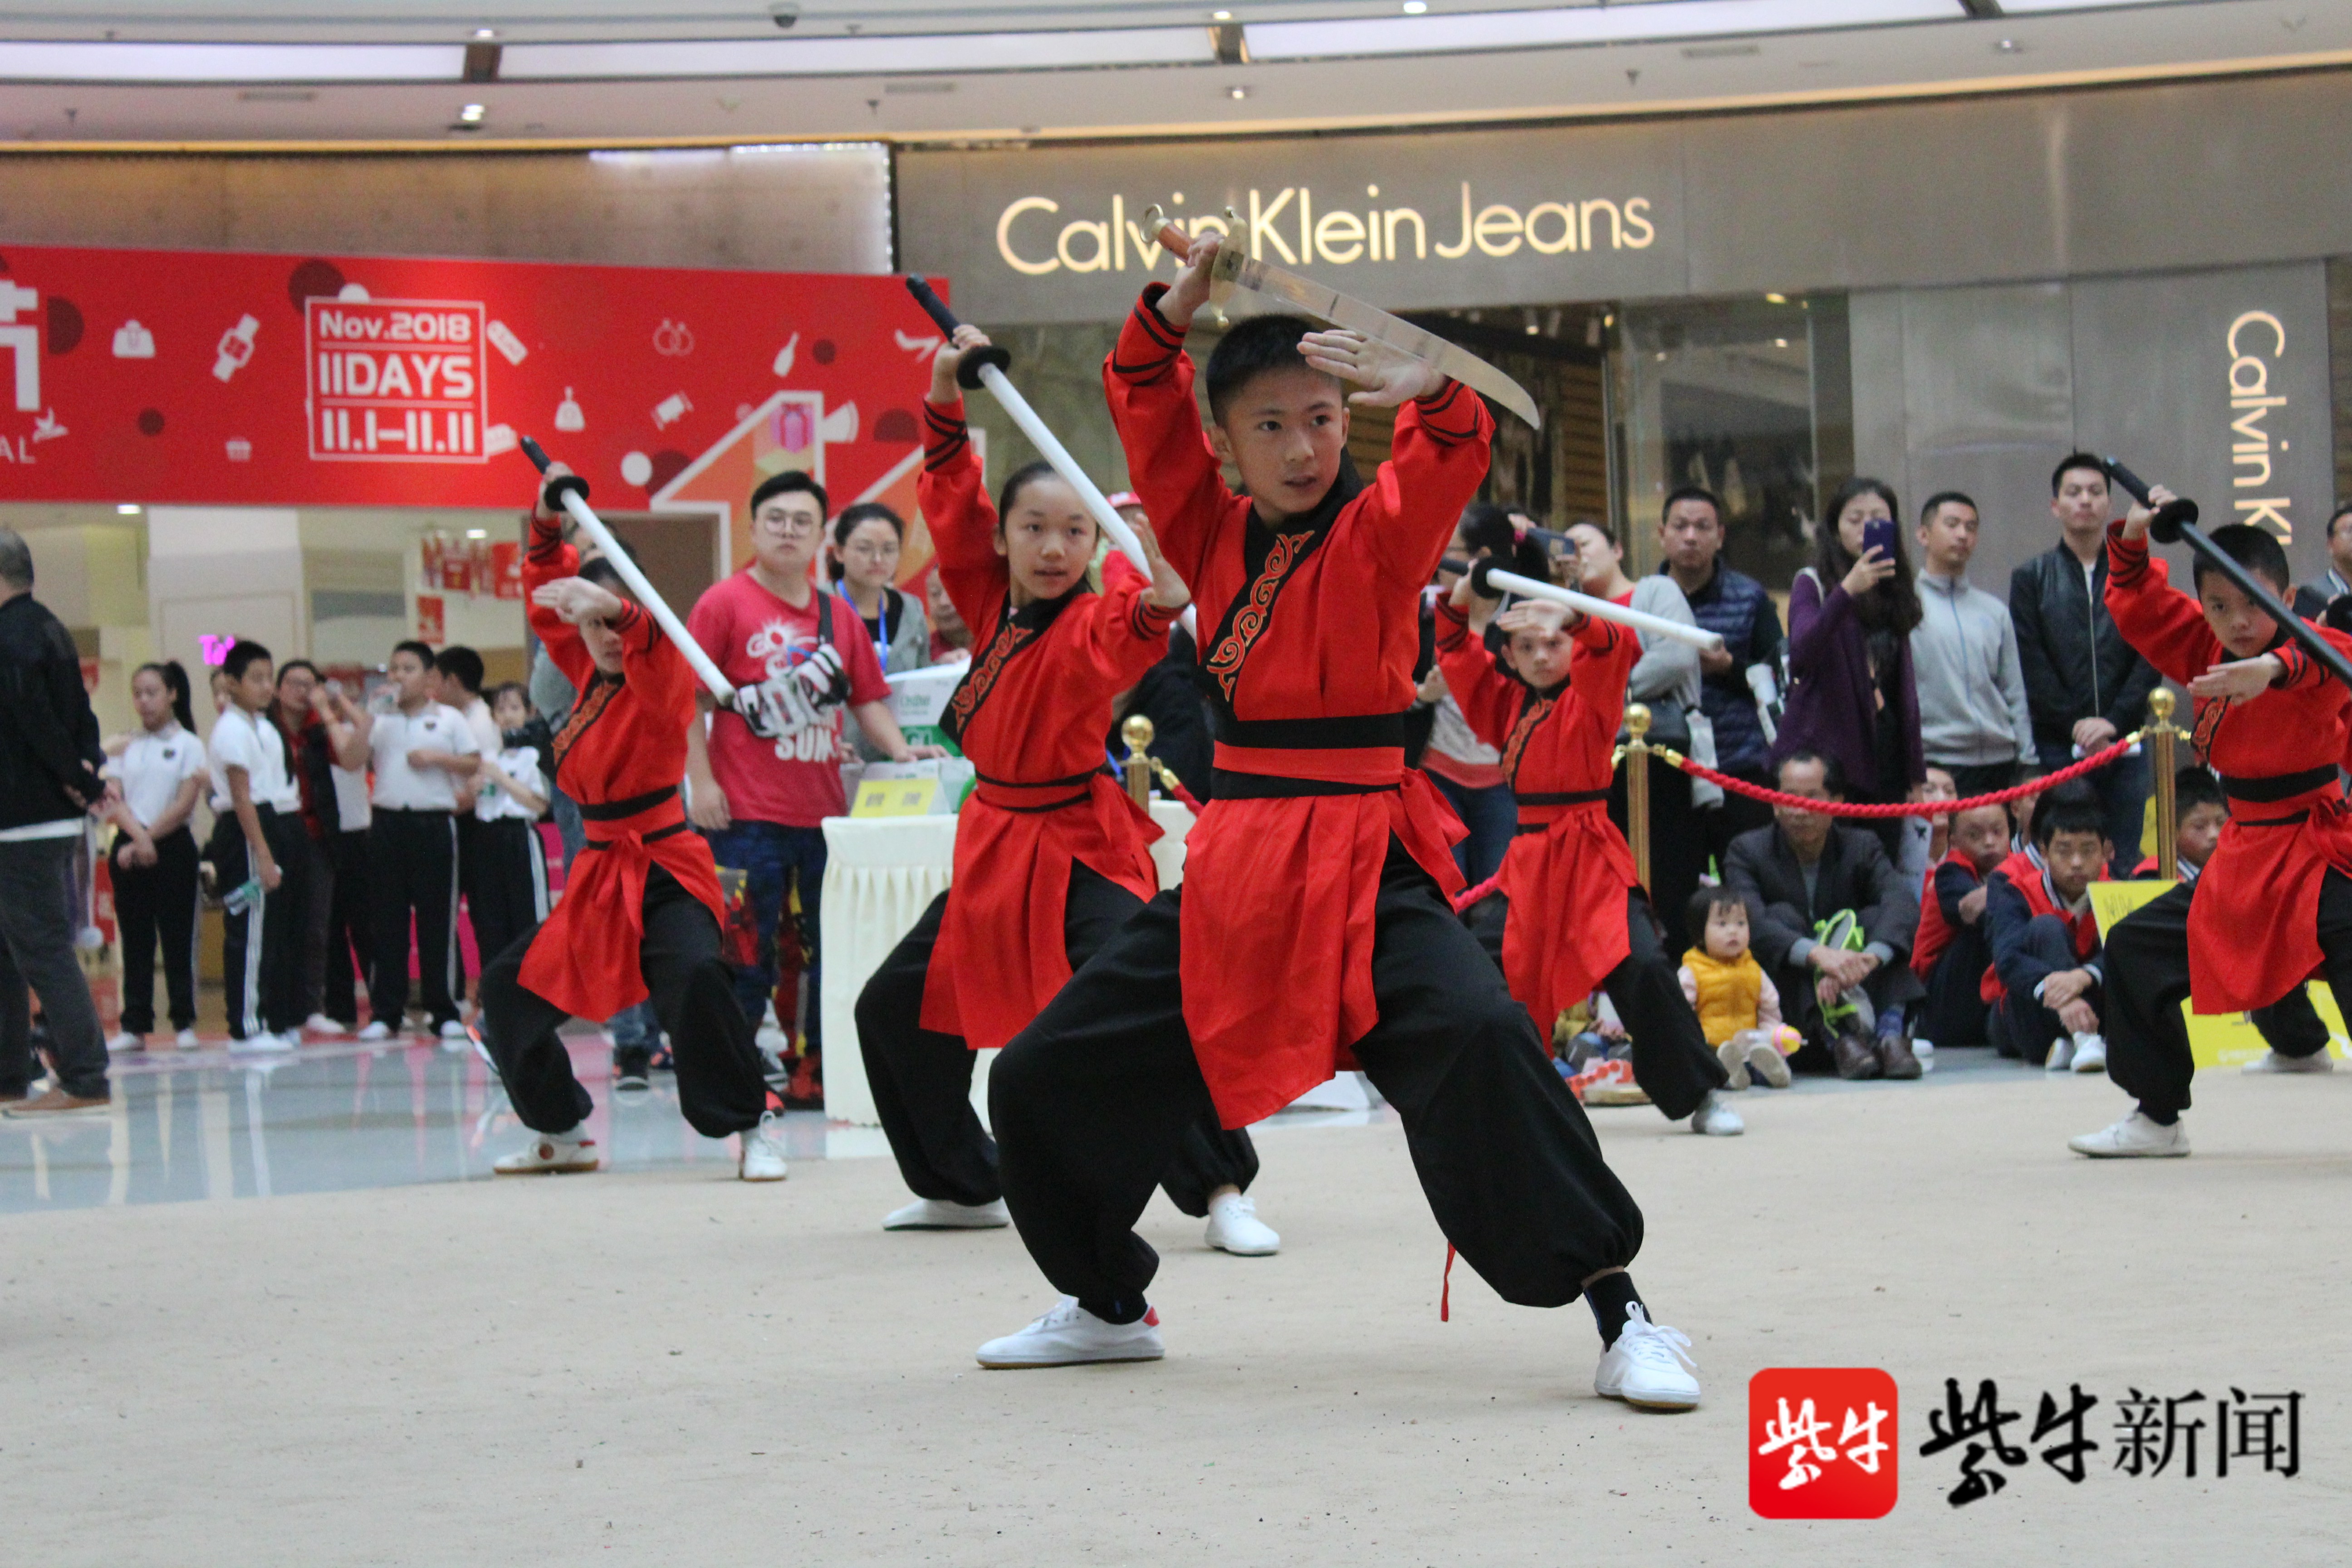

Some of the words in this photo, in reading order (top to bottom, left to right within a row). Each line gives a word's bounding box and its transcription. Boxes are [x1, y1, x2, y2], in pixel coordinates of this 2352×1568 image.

[1249, 184, 1426, 264] Klein
[1435, 181, 1655, 259] Jeans
[320, 310, 472, 343] Nov.2018
[2227, 310, 2288, 488] Calvin
